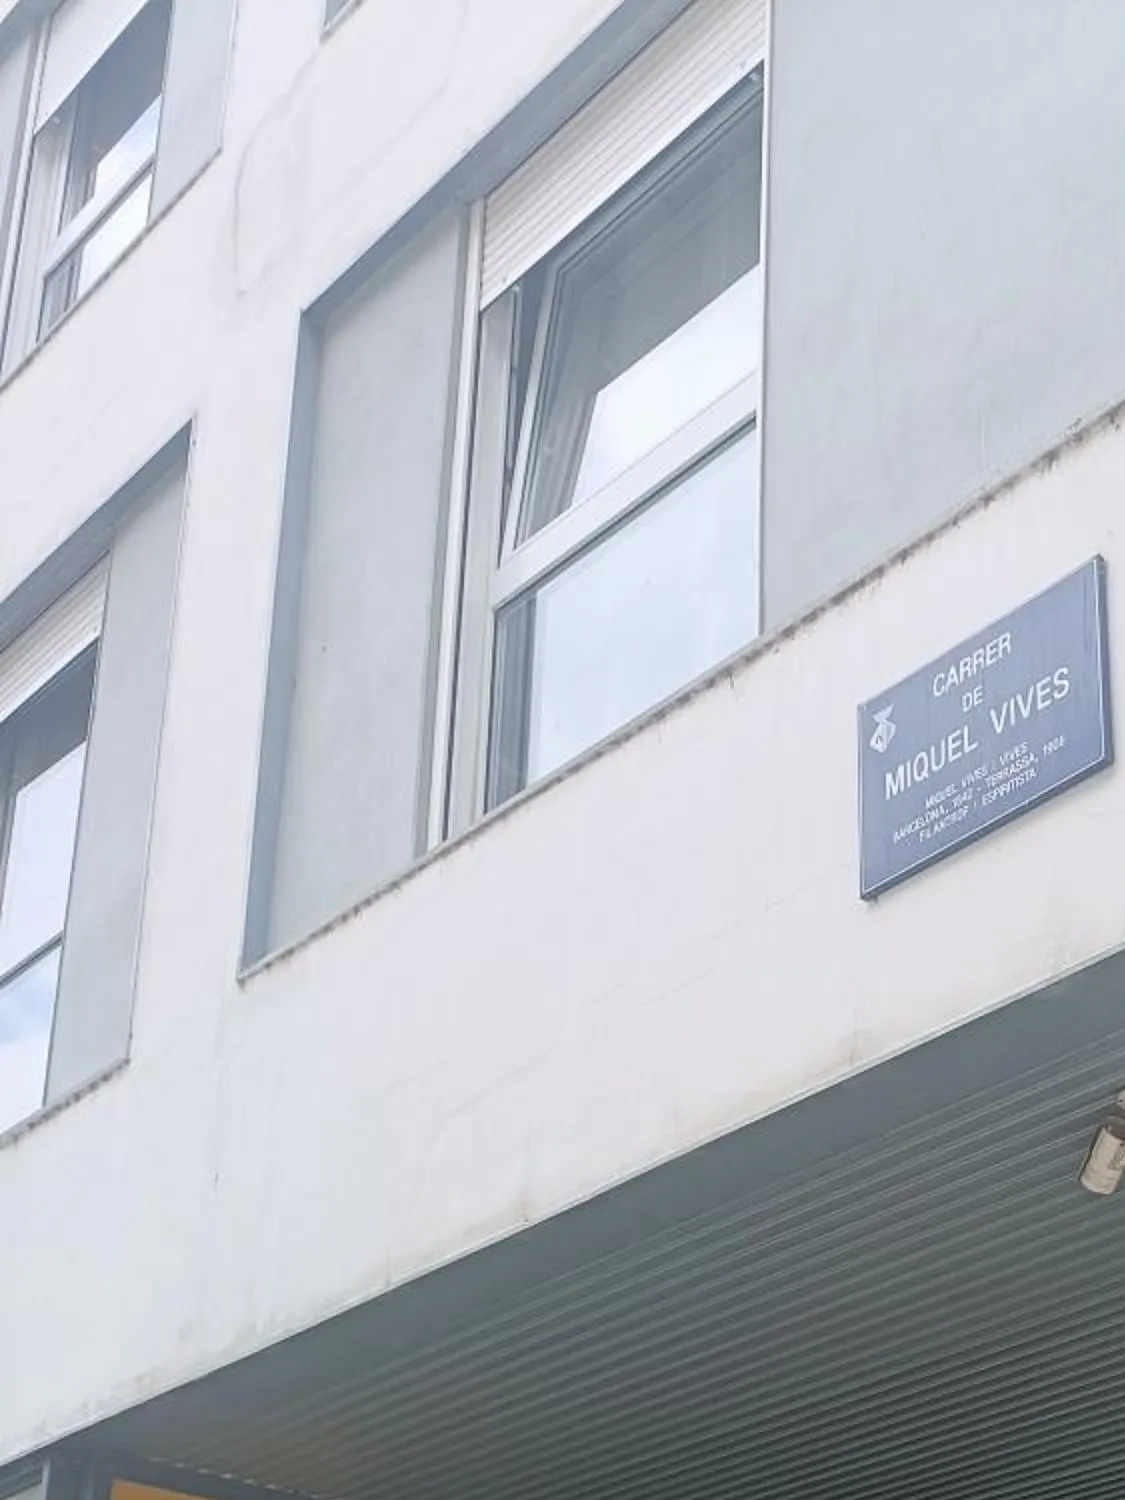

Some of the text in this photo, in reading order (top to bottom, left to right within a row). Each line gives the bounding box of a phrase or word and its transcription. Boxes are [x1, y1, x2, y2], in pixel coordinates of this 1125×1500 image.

[932, 632, 1012, 698] CARRER
[961, 686, 983, 713] DE
[884, 667, 1070, 801] MIQUEL VIVES
